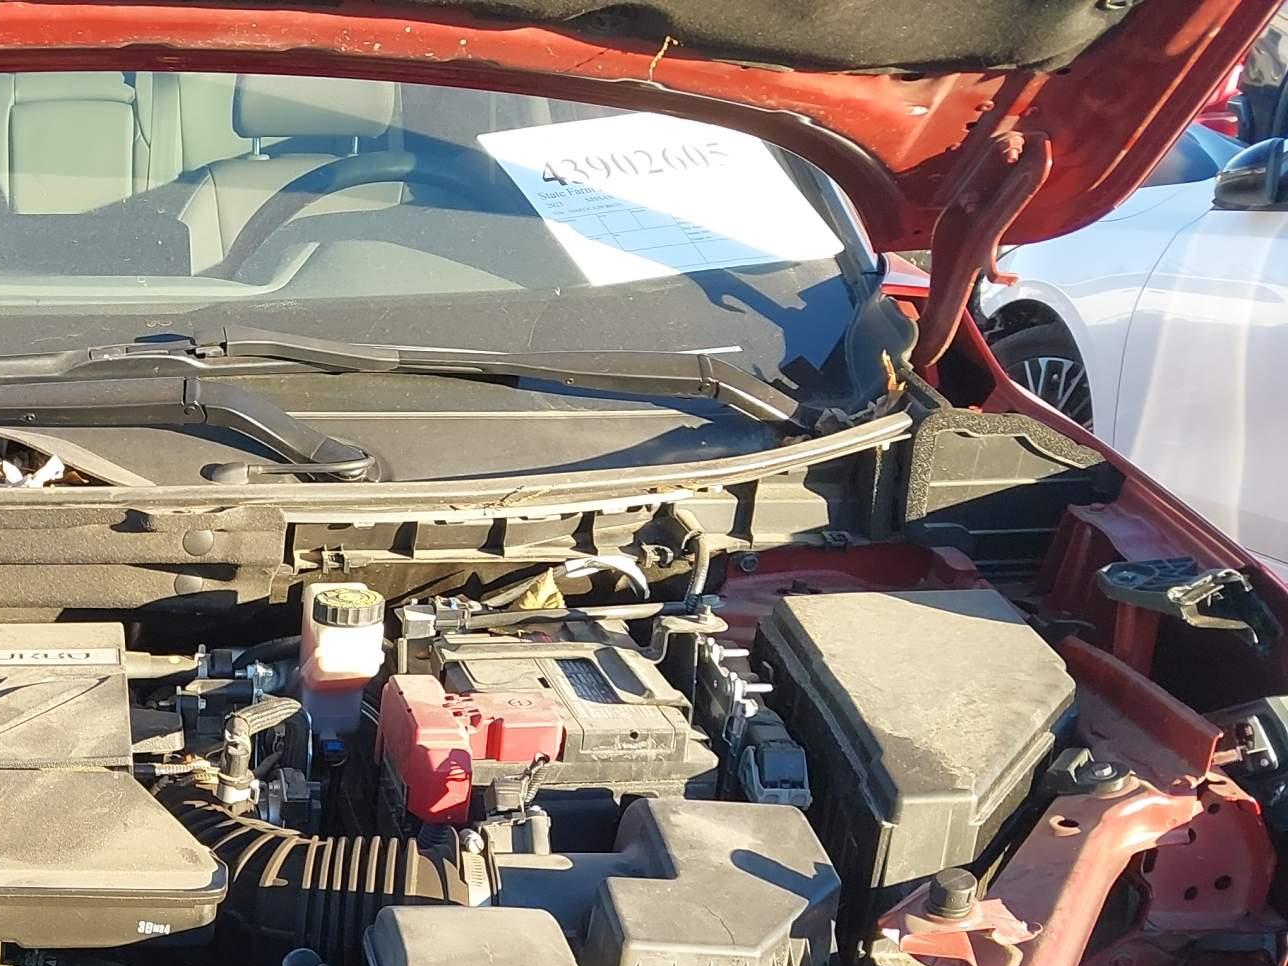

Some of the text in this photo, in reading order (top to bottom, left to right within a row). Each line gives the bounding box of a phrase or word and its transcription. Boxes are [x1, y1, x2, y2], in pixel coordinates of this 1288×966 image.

[542, 142, 728, 186] 43902605
[537, 186, 596, 201] State Farm
